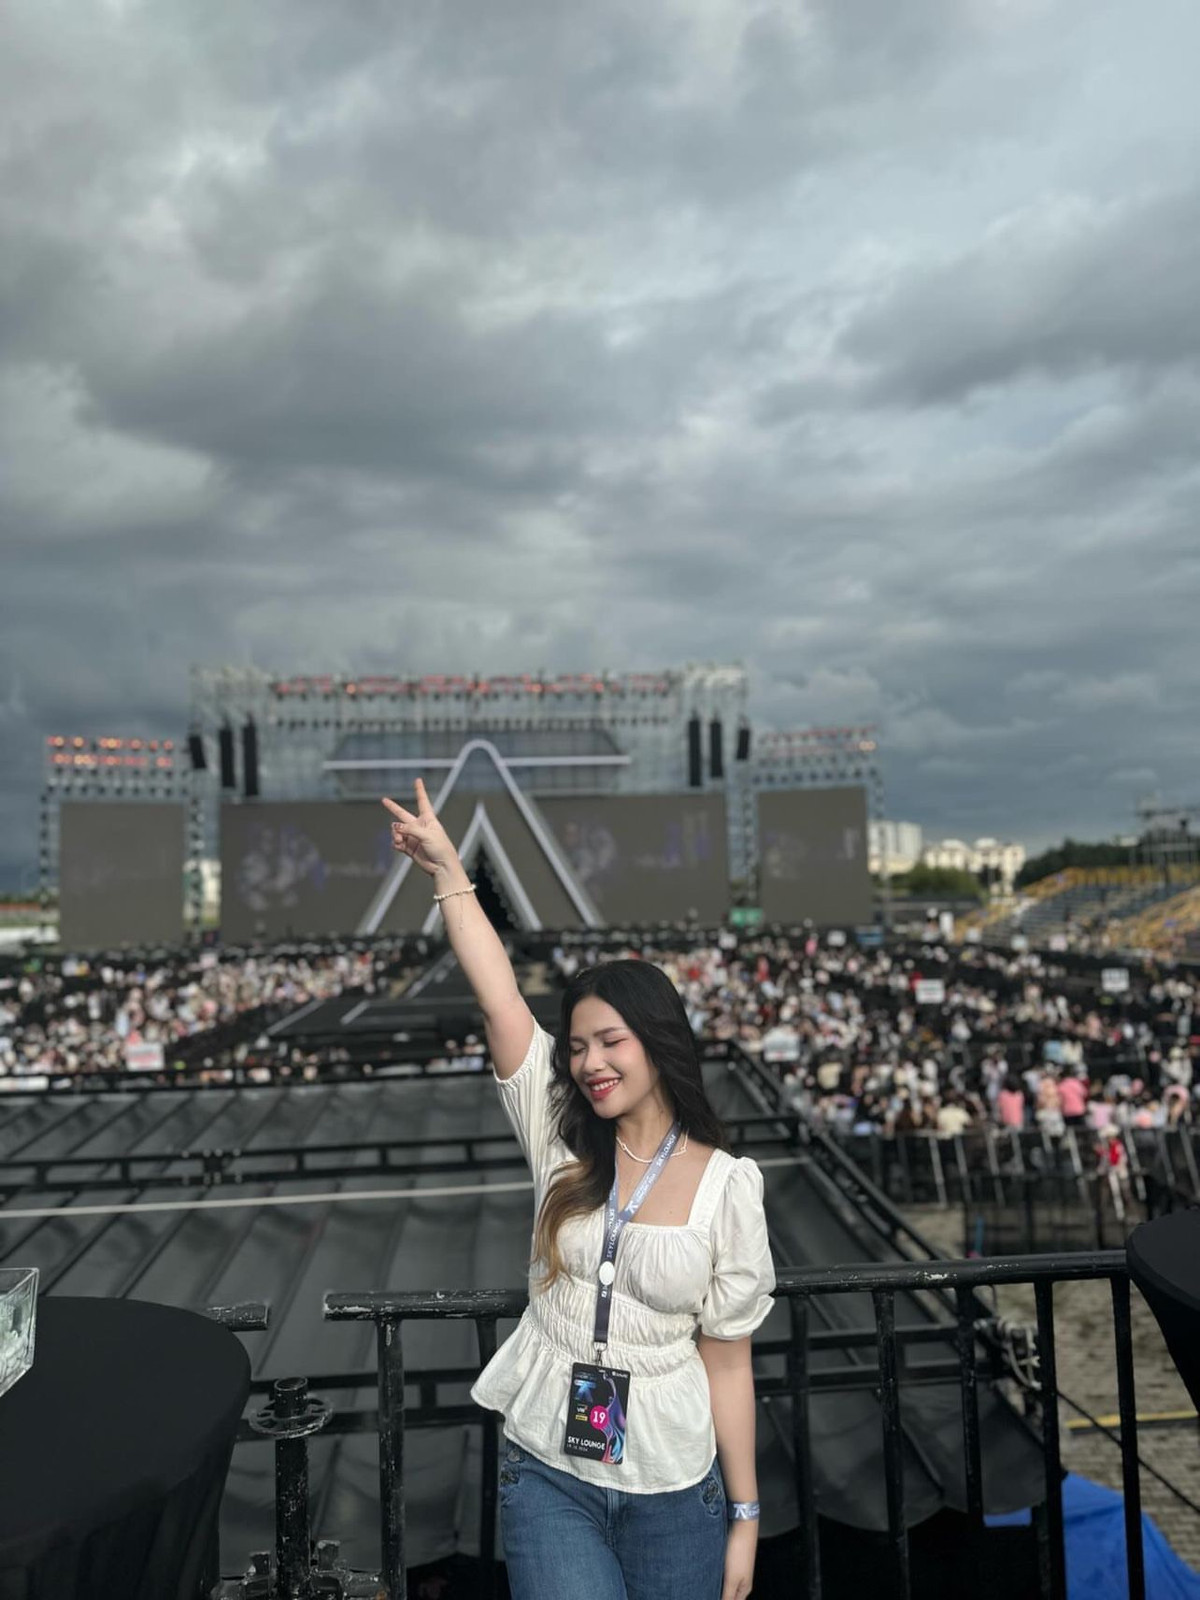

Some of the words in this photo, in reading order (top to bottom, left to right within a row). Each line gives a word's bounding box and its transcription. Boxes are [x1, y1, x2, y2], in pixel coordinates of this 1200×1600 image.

[593, 1411, 606, 1424] 19
[568, 1436, 579, 1444] SKY
[580, 1438, 605, 1450] LOUNGE
